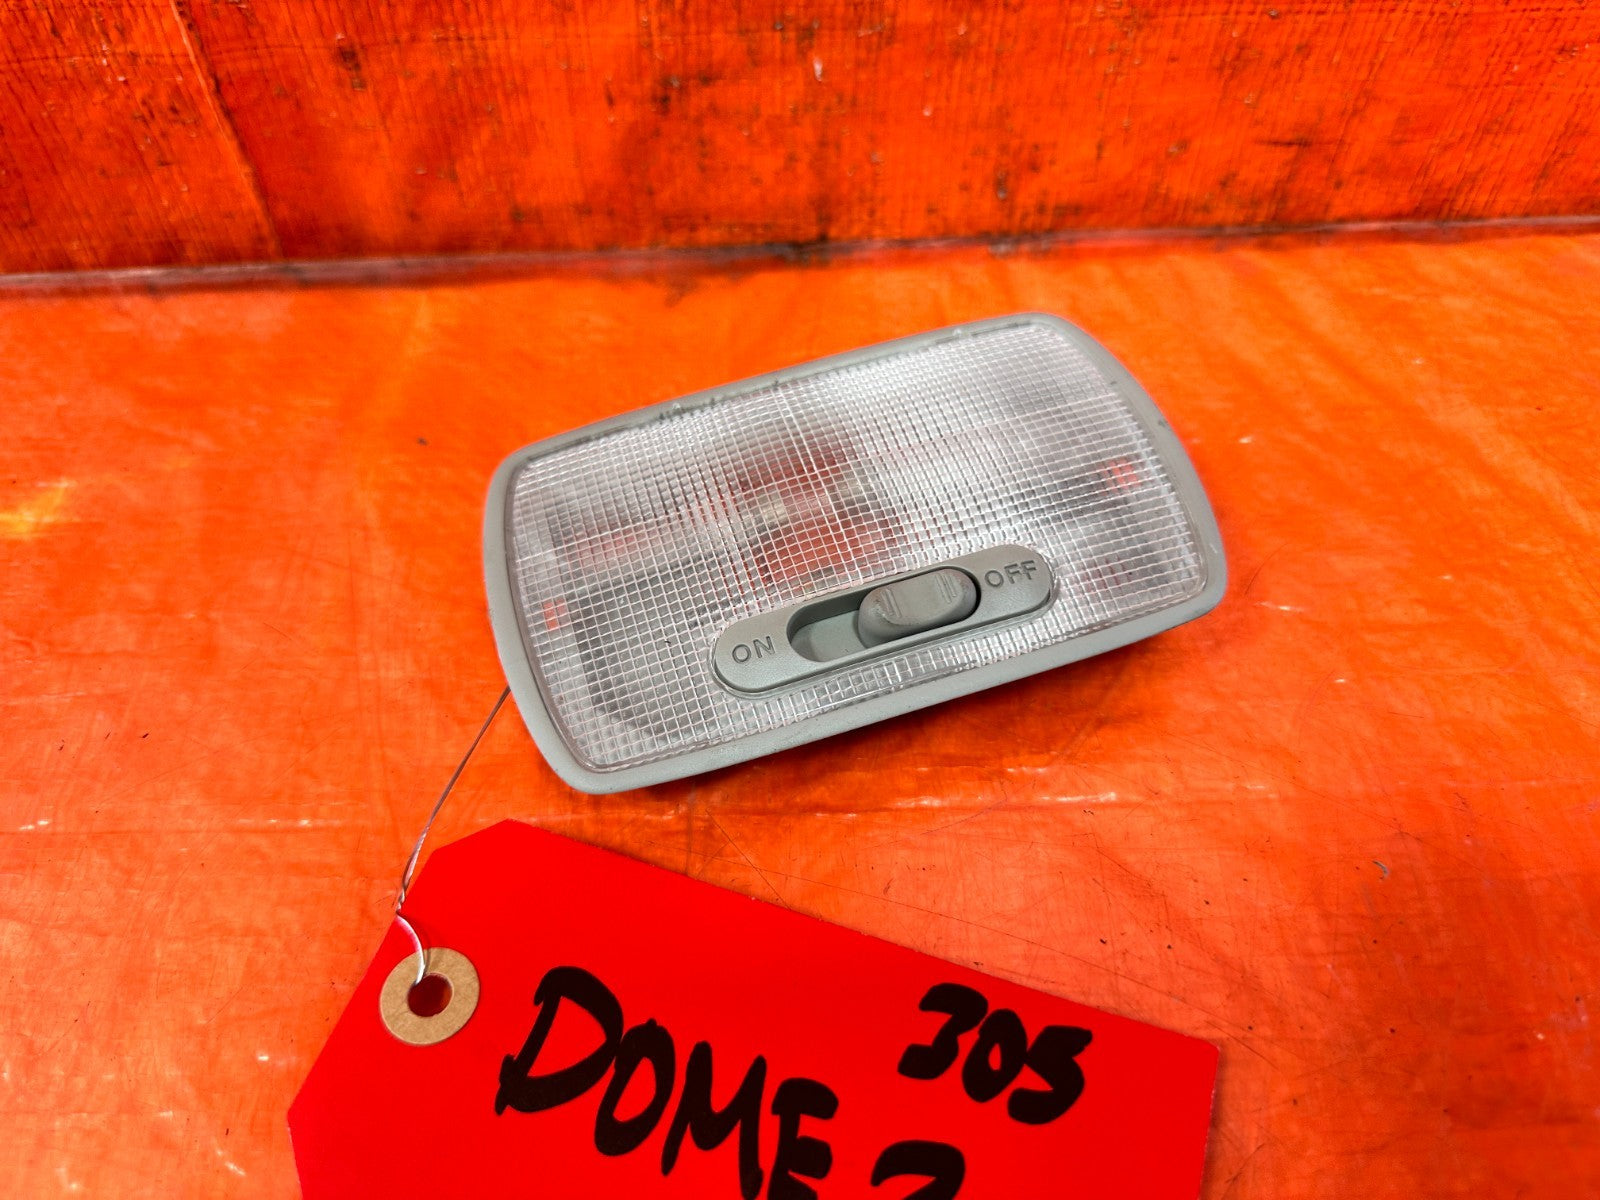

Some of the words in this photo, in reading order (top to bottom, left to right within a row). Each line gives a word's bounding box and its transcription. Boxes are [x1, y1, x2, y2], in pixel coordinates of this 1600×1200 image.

[984, 560, 1038, 588] OFF
[731, 635, 776, 664] ON
[495, 966, 839, 1200] DOME
[898, 983, 1093, 1125] 305
